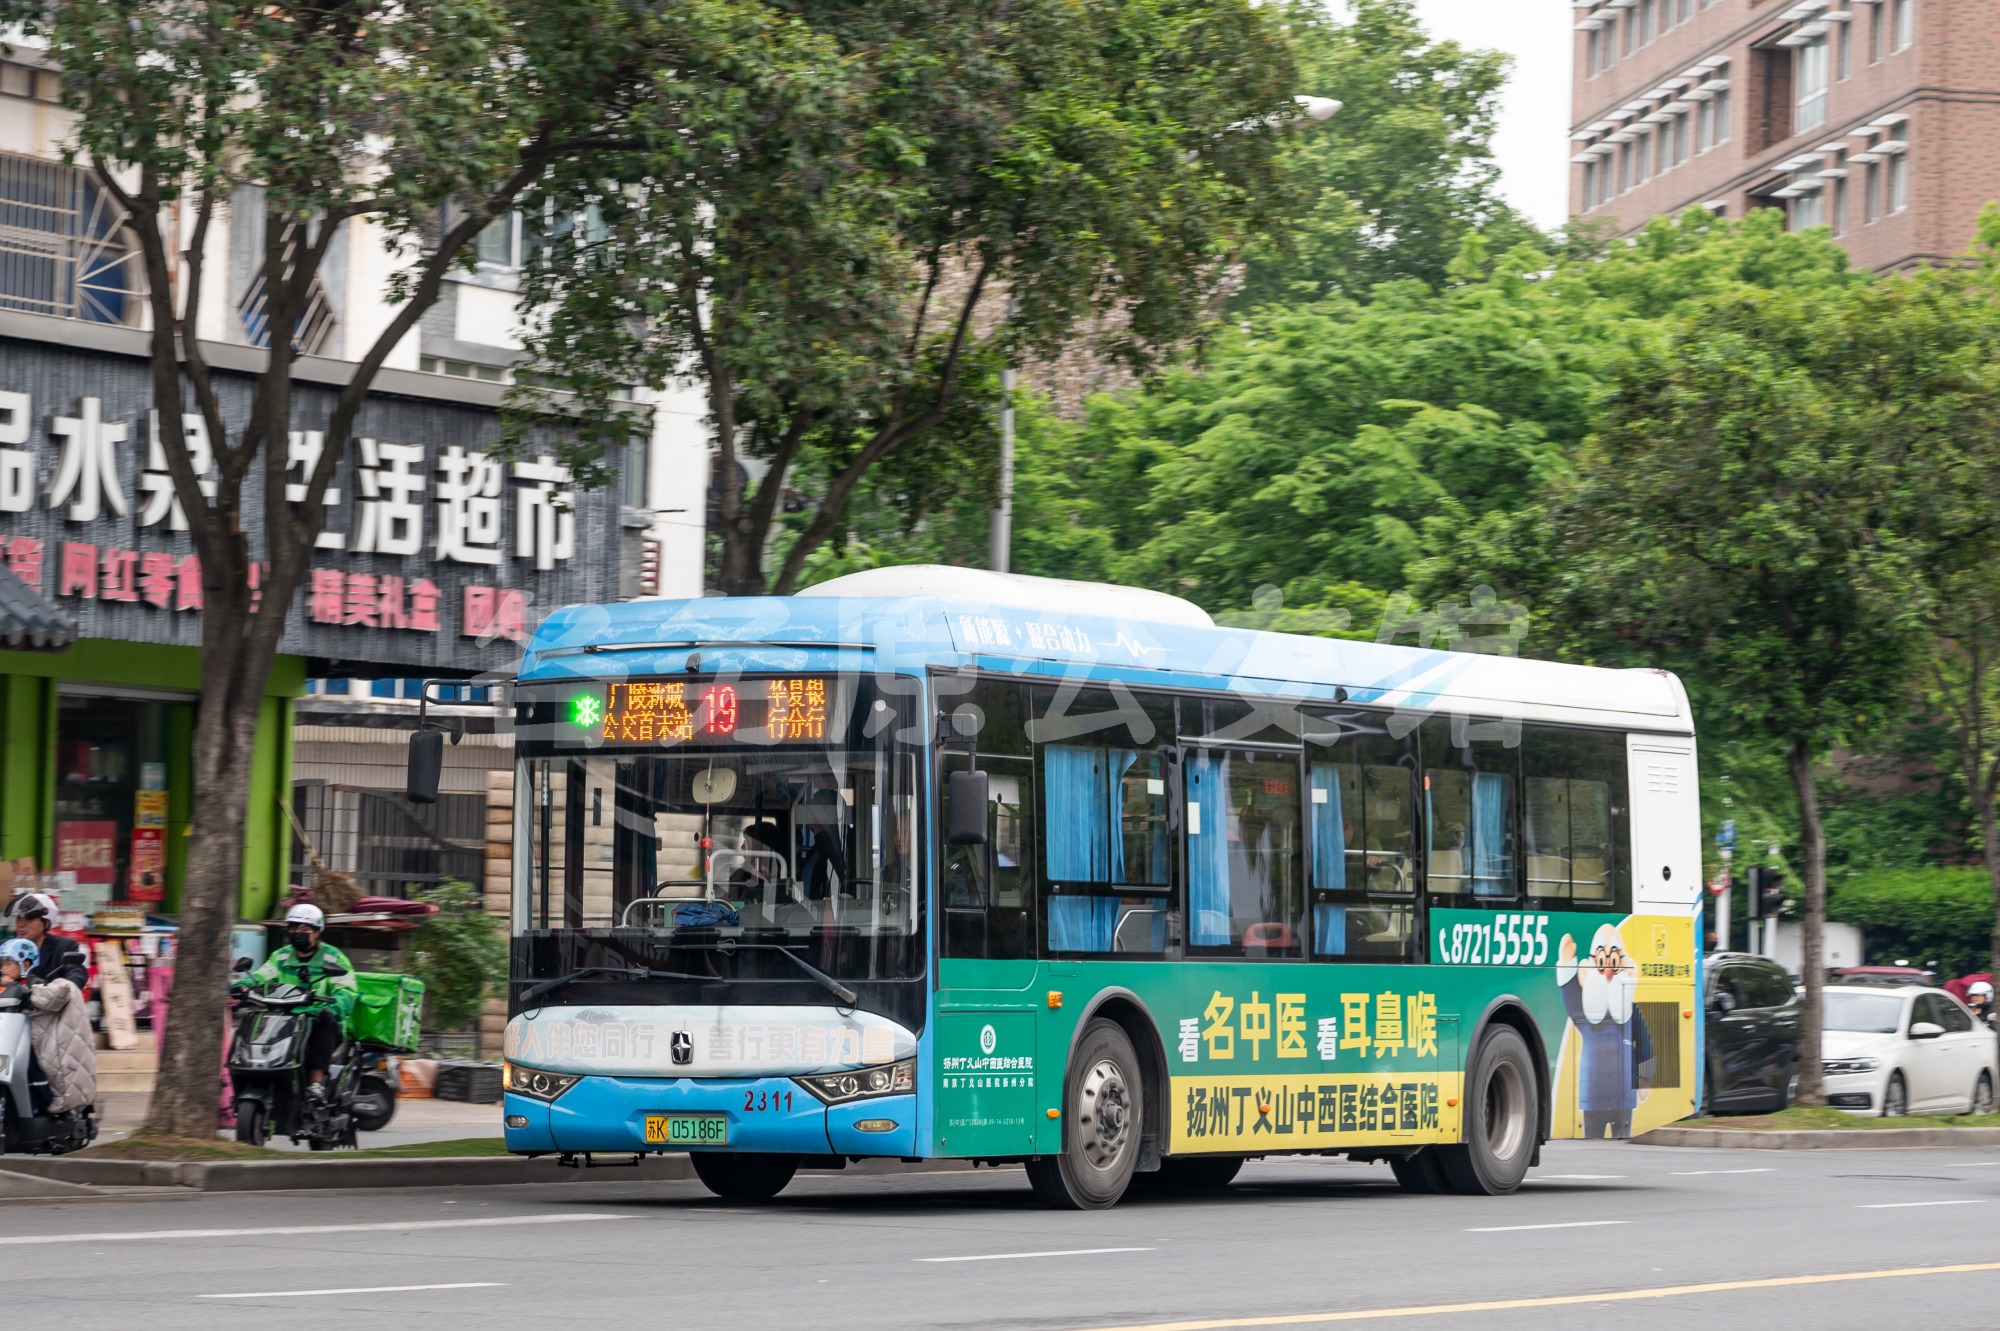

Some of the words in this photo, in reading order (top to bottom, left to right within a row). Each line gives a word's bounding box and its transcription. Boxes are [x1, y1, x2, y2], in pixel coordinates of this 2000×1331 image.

[705, 686, 737, 734] 19
[1451, 914, 1549, 965] 87215555
[943, 1057, 1033, 1070] 扬州丁义山中西医结合医院
[943, 1077, 1034, 1088] 南京丁义山医院扬州分院
[744, 1090, 792, 1112] 2311
[1186, 1082, 1439, 1138] 扬州丁义山中西医结合医院
